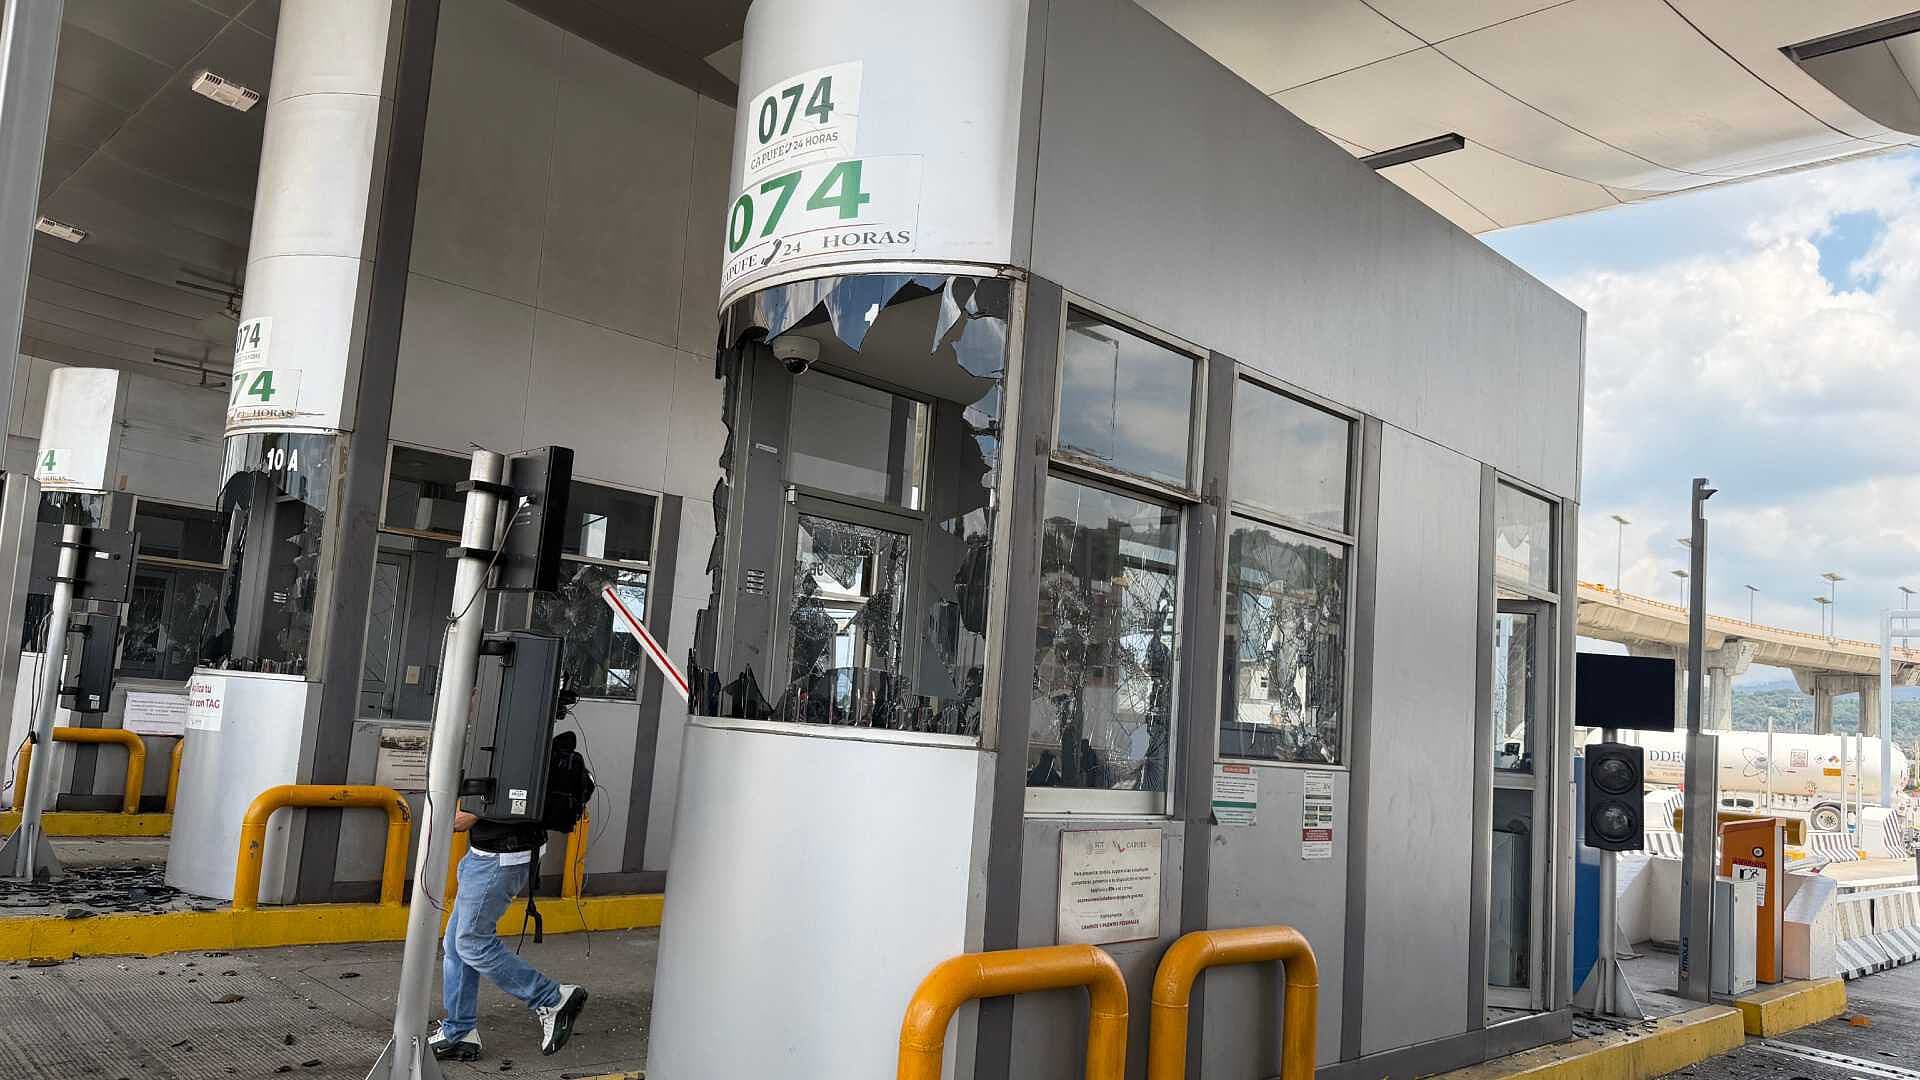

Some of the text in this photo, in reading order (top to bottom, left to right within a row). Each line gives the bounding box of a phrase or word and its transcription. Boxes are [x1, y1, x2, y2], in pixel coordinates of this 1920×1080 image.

[758, 75, 834, 144] 074
[751, 144, 785, 169] CAPUFE
[805, 132, 838, 147] HORAS
[729, 160, 870, 253] 074
[783, 241, 801, 256] 24
[823, 231, 911, 248] HORAS
[253, 408, 295, 418] HORAS
[267, 447, 298, 471] 10 A
[206, 698, 220, 709] TAG
